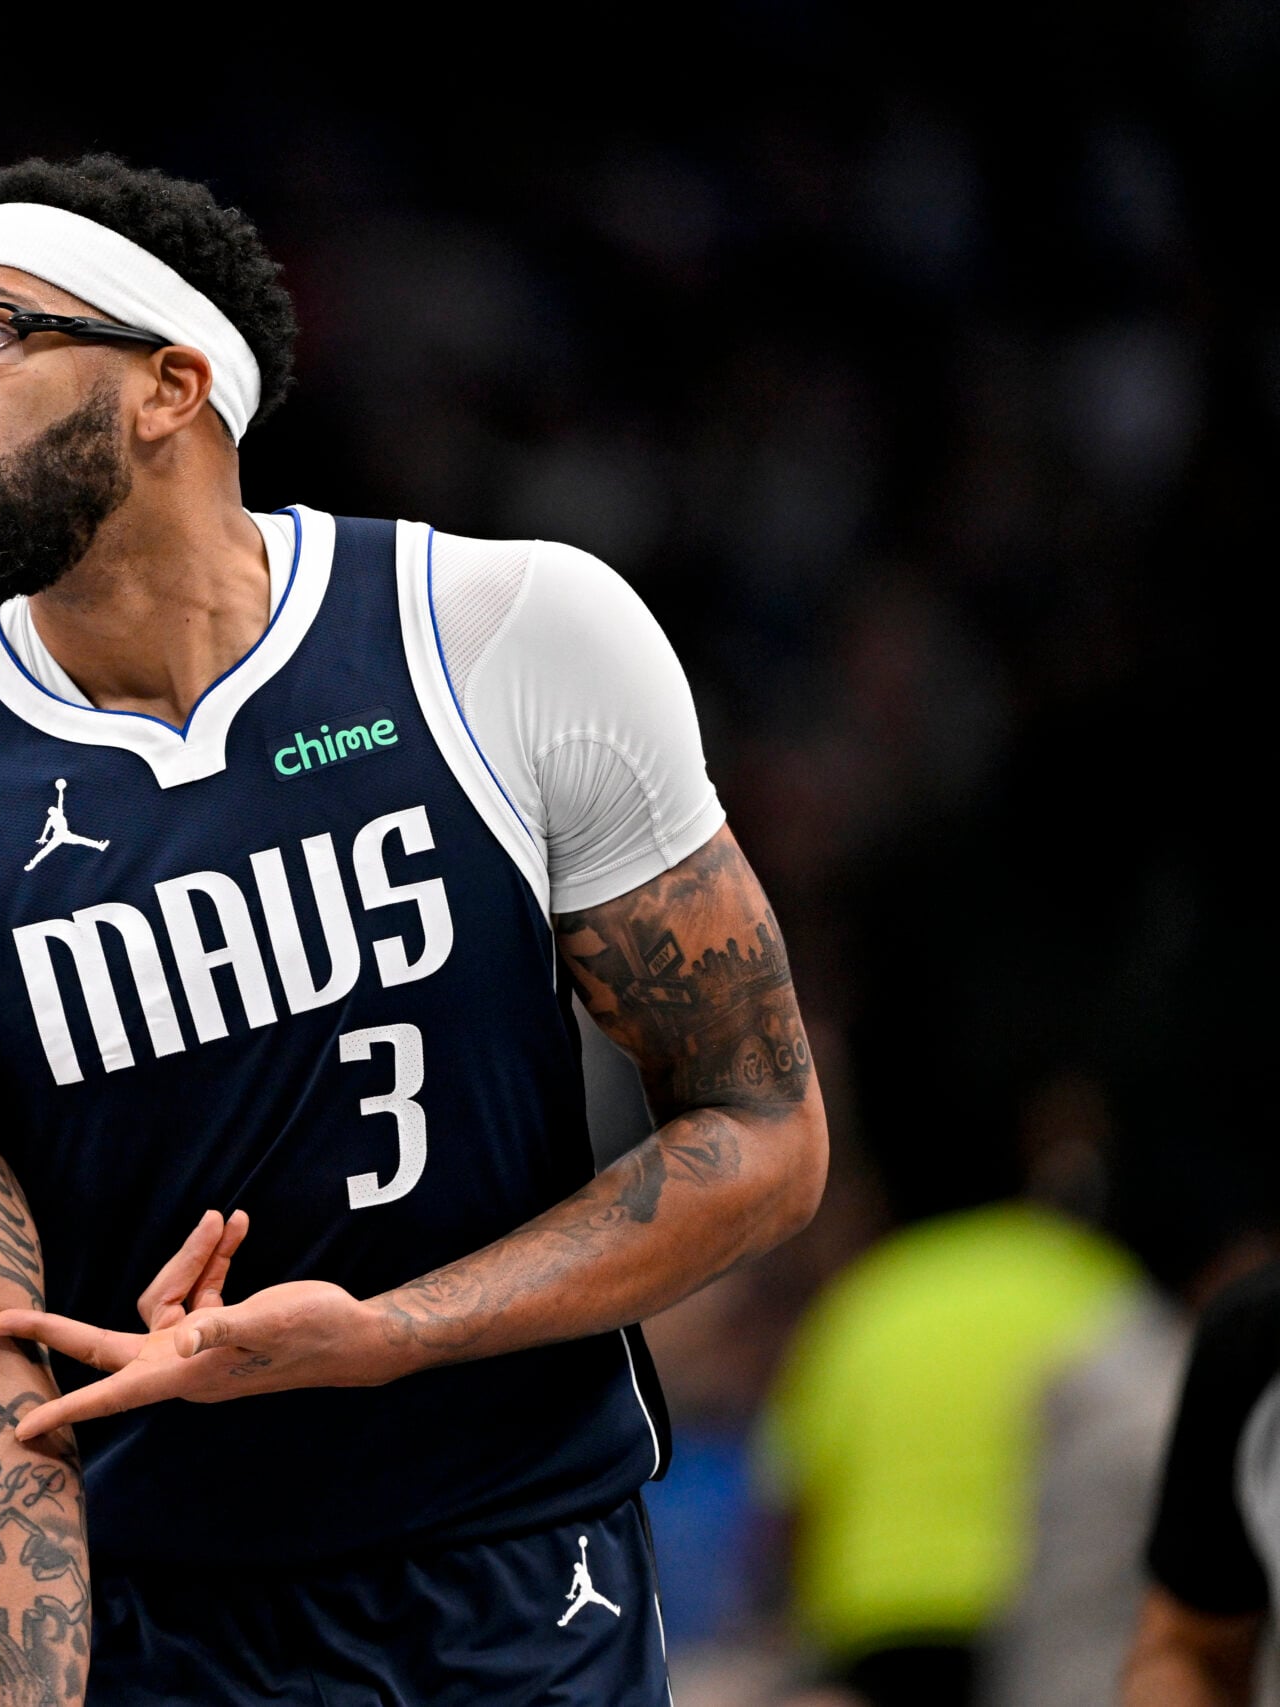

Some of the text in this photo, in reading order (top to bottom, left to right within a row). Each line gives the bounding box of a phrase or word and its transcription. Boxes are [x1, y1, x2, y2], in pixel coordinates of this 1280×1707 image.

[274, 718, 399, 776] chime
[11, 804, 455, 1087] MAVS
[338, 1022, 428, 1211] 3
